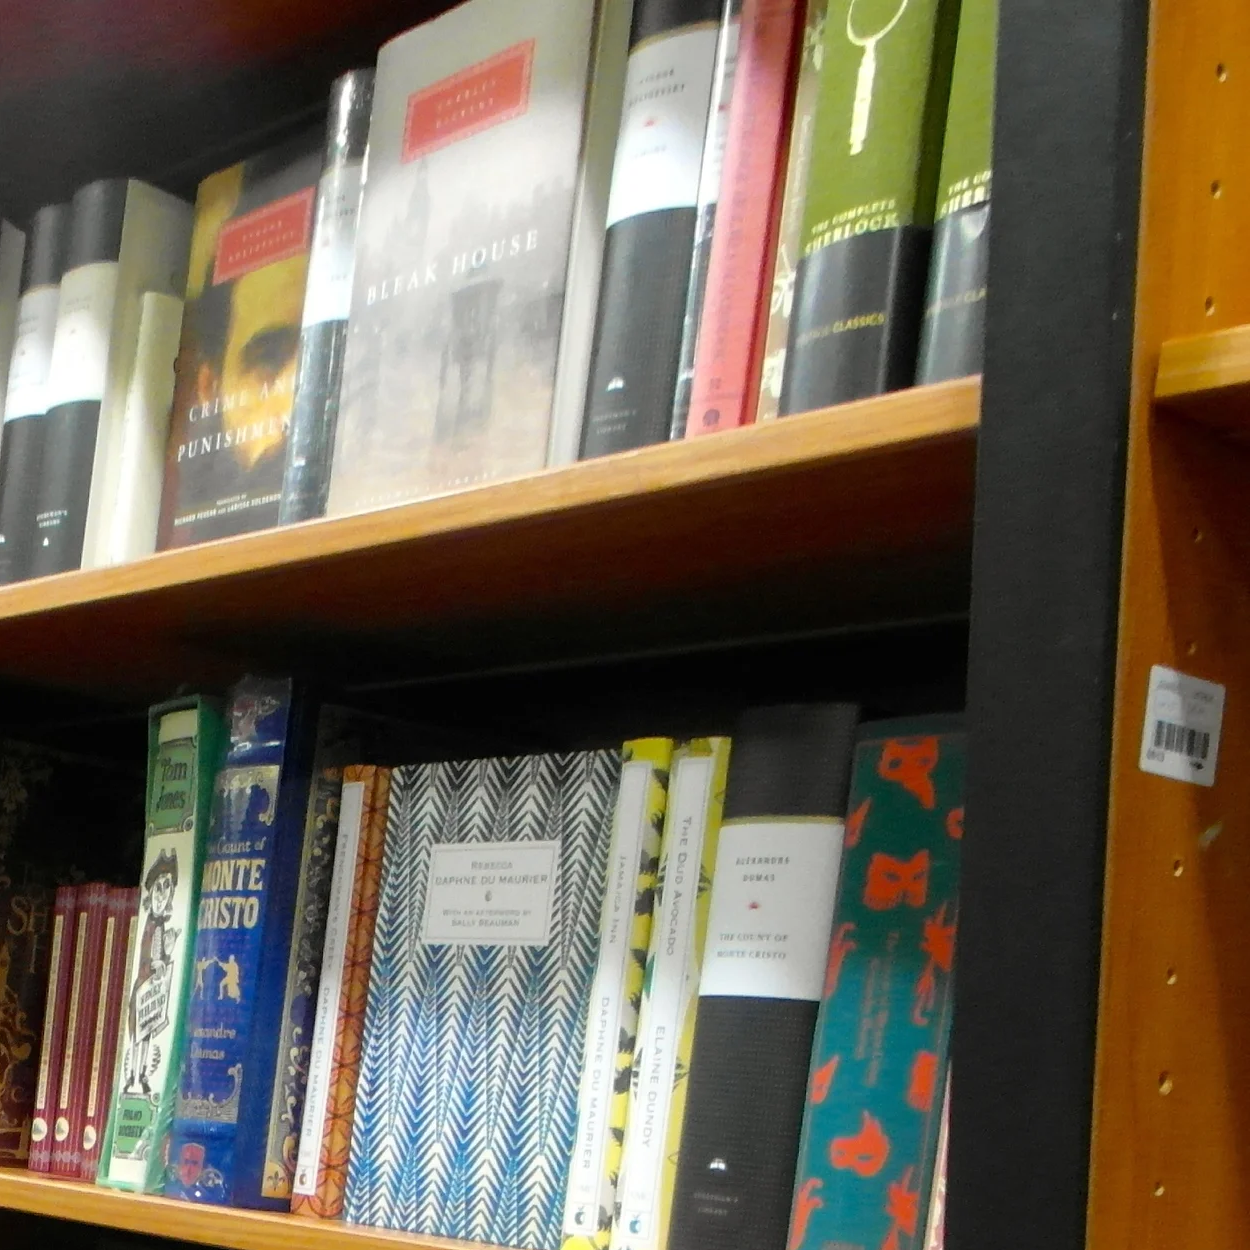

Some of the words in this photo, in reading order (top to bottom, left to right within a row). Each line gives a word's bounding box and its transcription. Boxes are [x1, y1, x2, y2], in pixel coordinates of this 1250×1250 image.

[832, 199, 896, 224] COMPLETE
[805, 212, 899, 254] SHERLOCK
[366, 264, 439, 306] BLEAK
[452, 229, 539, 276] HOUSE
[833, 312, 886, 334] CLASSICS
[189, 388, 249, 423] CRIME
[177, 414, 292, 463] PUNISHMEN
[161, 756, 188, 783] Tom
[680, 816, 691, 845] THE
[202, 859, 266, 892] MONTE
[435, 875, 476, 886] DAPHNE
[481, 875, 496, 885] DU
[499, 874, 548, 885] MAURIER
[674, 853, 686, 884] DUD
[197, 896, 259, 930] CRISTO
[665, 887, 684, 956] AVOCADO
[317, 985, 332, 1044] DAPHNE
[594, 996, 610, 1063] DAPHNE
[650, 1025, 665, 1084] ELAINE
[590, 1068, 600, 1091] DU
[582, 1095, 598, 1170] MAURIER
[640, 1086, 657, 1149] DUNDY
